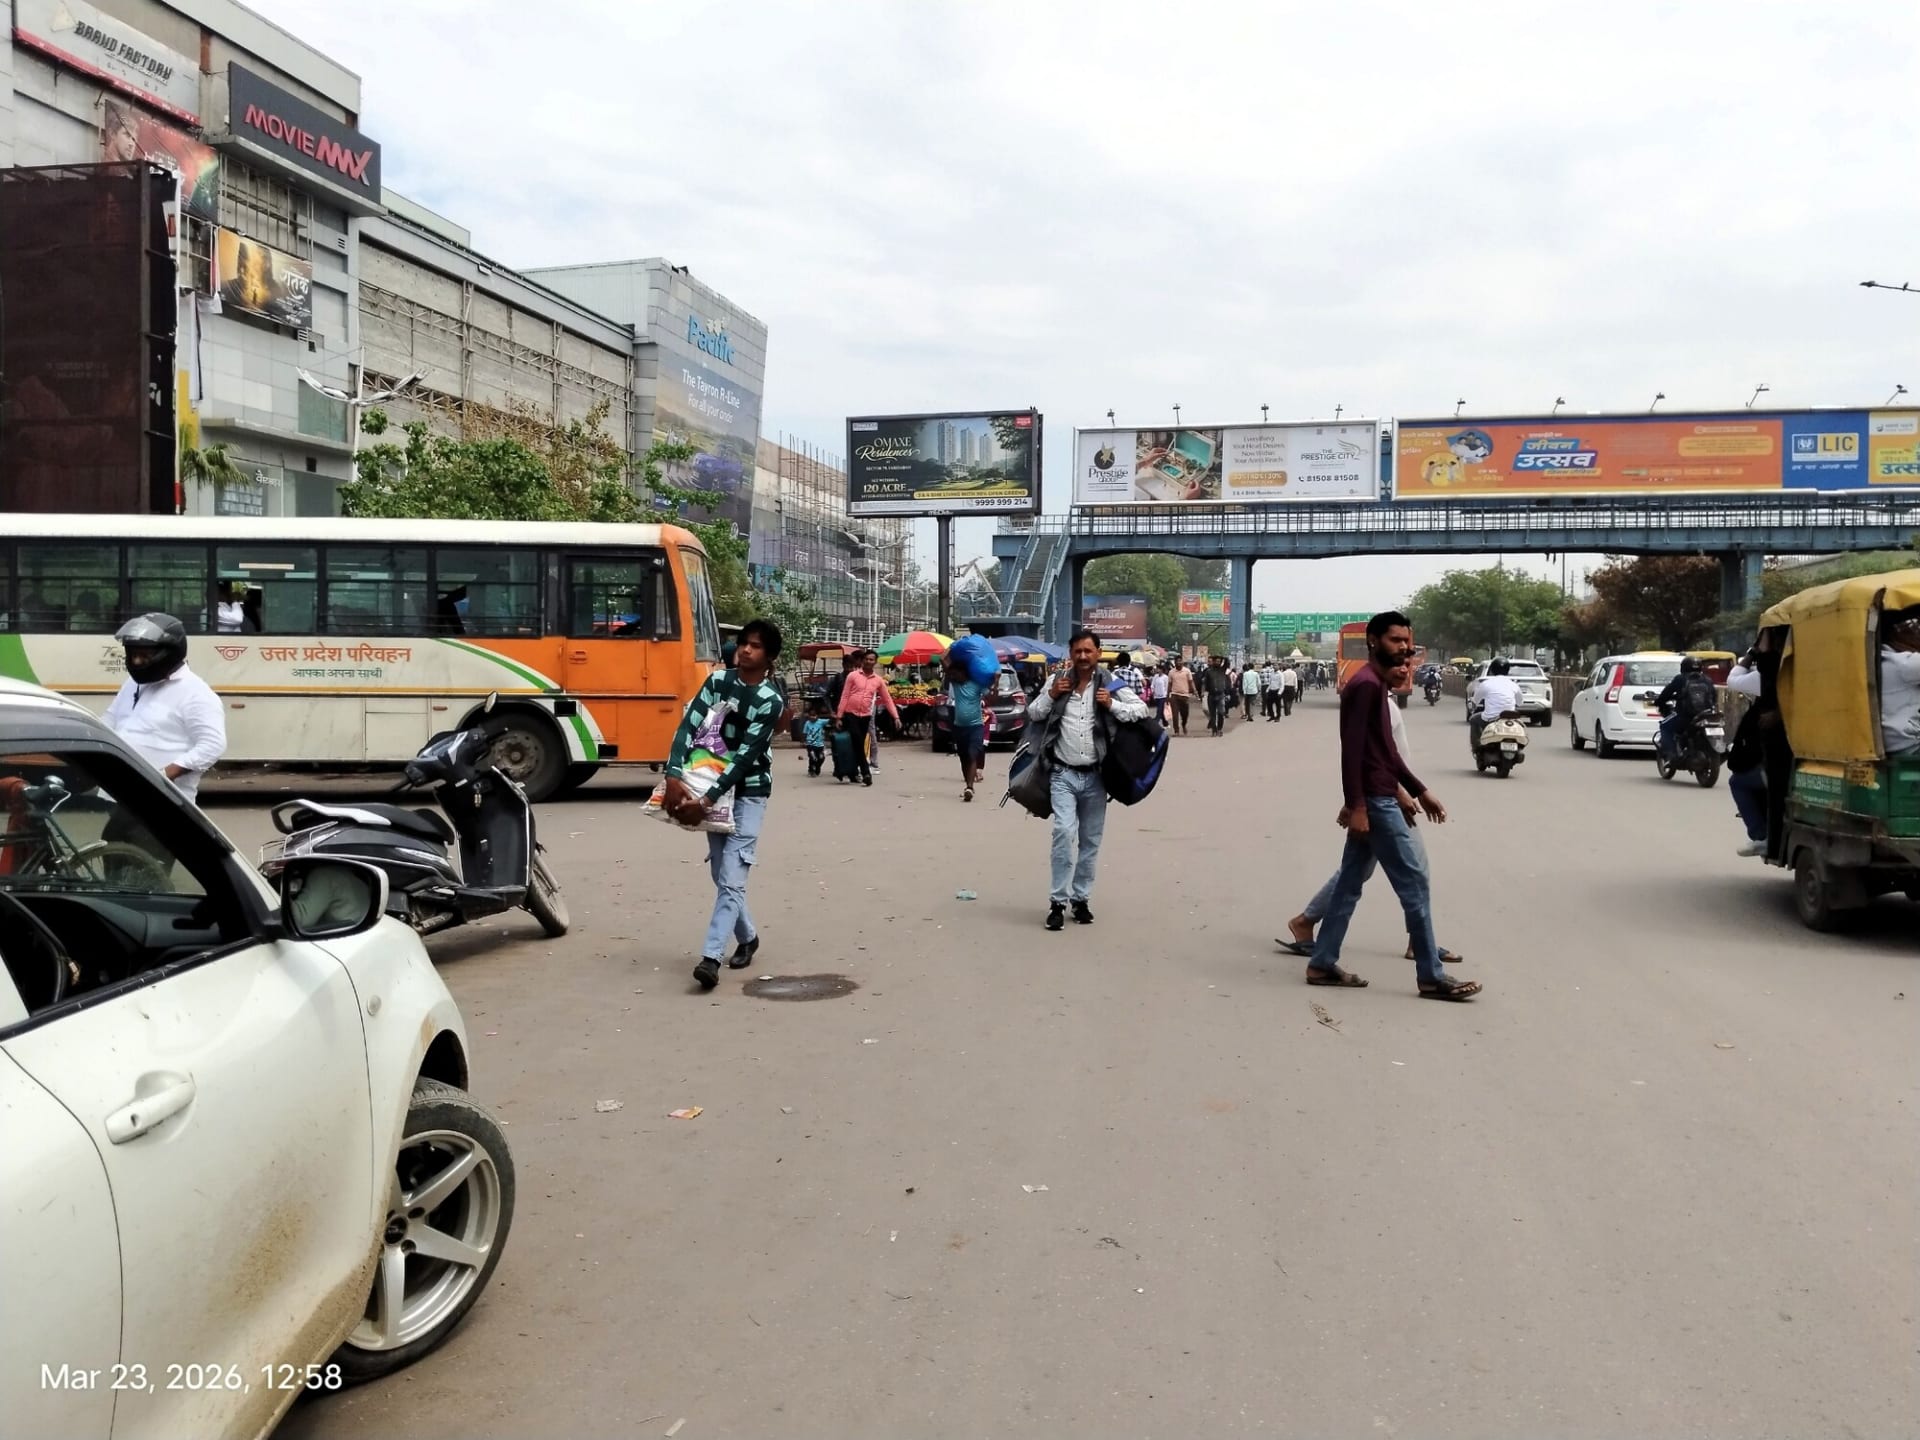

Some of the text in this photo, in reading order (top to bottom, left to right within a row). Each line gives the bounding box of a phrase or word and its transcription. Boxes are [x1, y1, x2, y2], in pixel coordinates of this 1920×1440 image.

[117, 43, 173, 81] FACTORY
[687, 313, 735, 366] Pacific
[682, 368, 696, 388] The
[697, 375, 719, 400] Tayron
[873, 436, 912, 449] OMAXE
[1525, 439, 1576, 451] जीवन
[1822, 436, 1853, 452] LIC
[855, 444, 920, 462] Residences
[1301, 452, 1355, 461] PRESTIGE CITY
[1516, 452, 1596, 468] उत्सव
[1088, 467, 1129, 480] Prestige
[863, 483, 907, 493] 120 ACRE
[259, 641, 412, 663] उत्तर प्रदेश परिवहन
[292, 667, 382, 679] आपका अपना साथी
